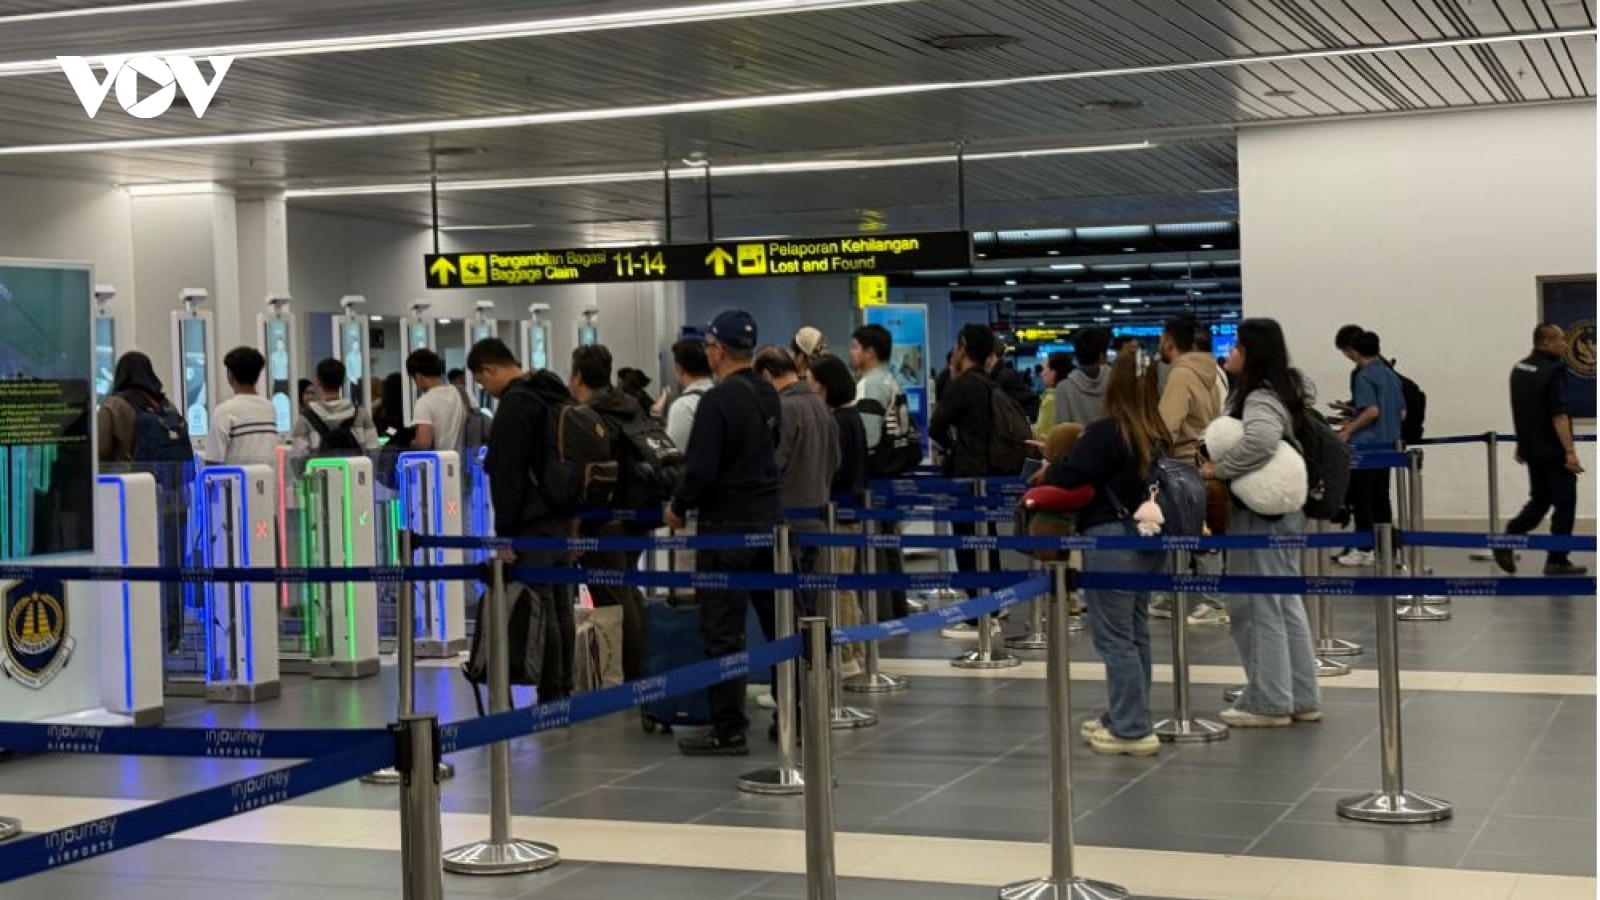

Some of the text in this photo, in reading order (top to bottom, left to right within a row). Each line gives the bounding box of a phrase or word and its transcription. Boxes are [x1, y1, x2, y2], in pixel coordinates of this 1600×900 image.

[769, 238, 919, 258] Pelaporan Kehilangan
[490, 251, 606, 269] Pengambilan Bagasi
[613, 250, 666, 276] 11-14
[770, 256, 876, 273] Lost and Found
[491, 265, 579, 283] Baggage Claim
[45, 816, 117, 852] injourney
[47, 838, 114, 867] AIRPORTS
